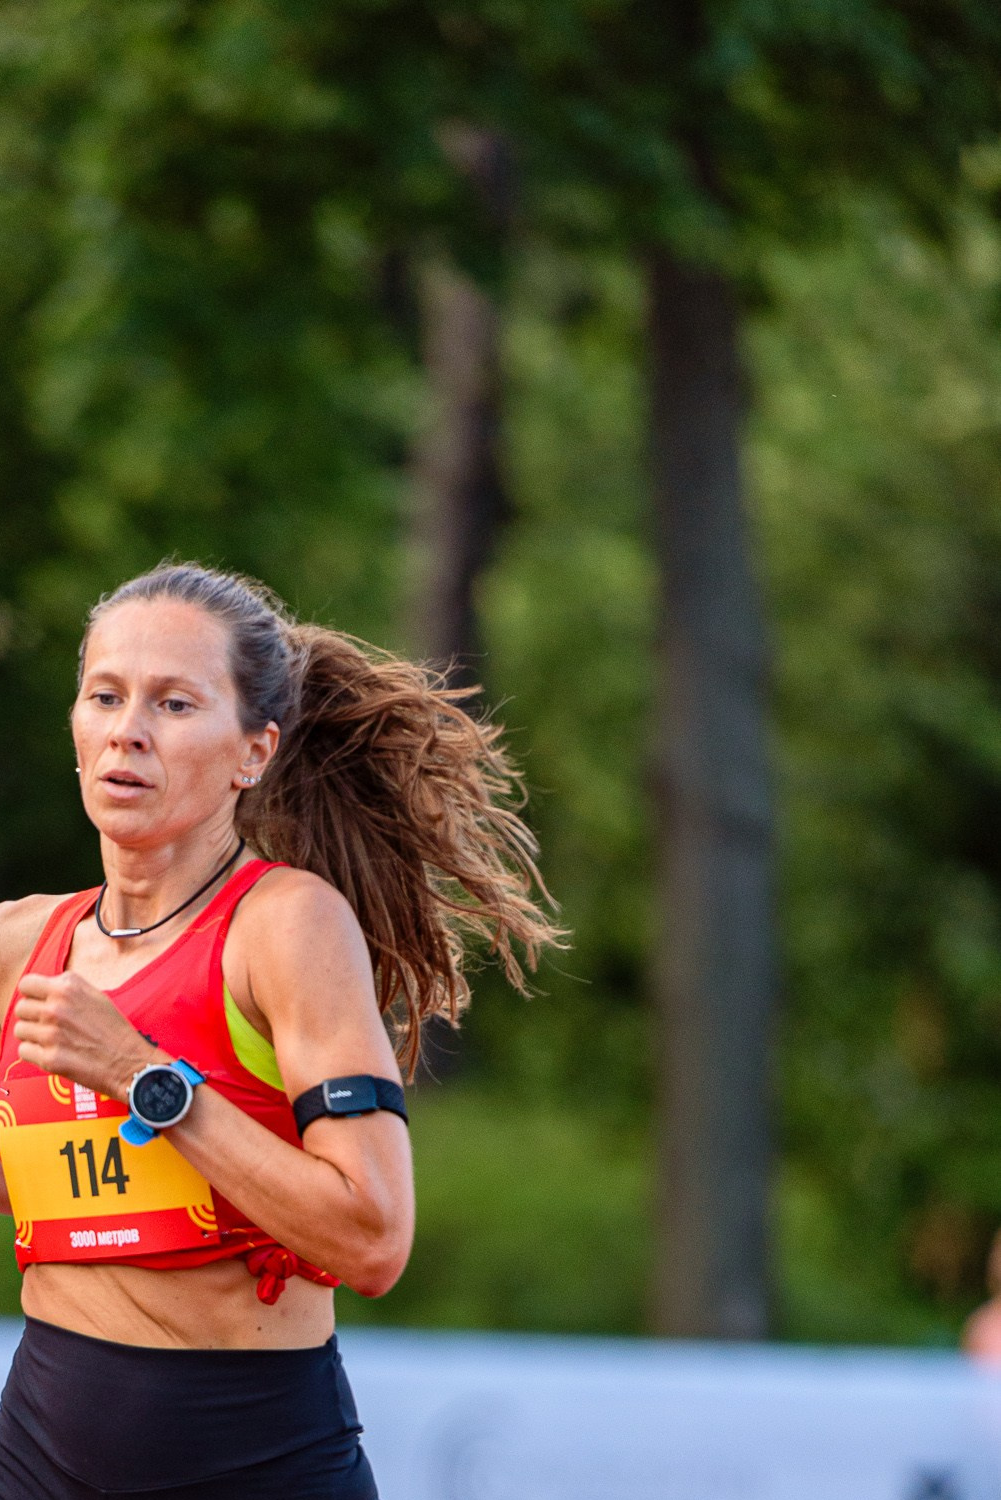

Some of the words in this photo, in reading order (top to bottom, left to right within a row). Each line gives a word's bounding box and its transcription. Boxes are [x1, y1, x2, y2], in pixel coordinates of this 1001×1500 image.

[59, 1136, 130, 1198] 114
[69, 1229, 97, 1248] 3000
[97, 1228, 140, 1247] метров
